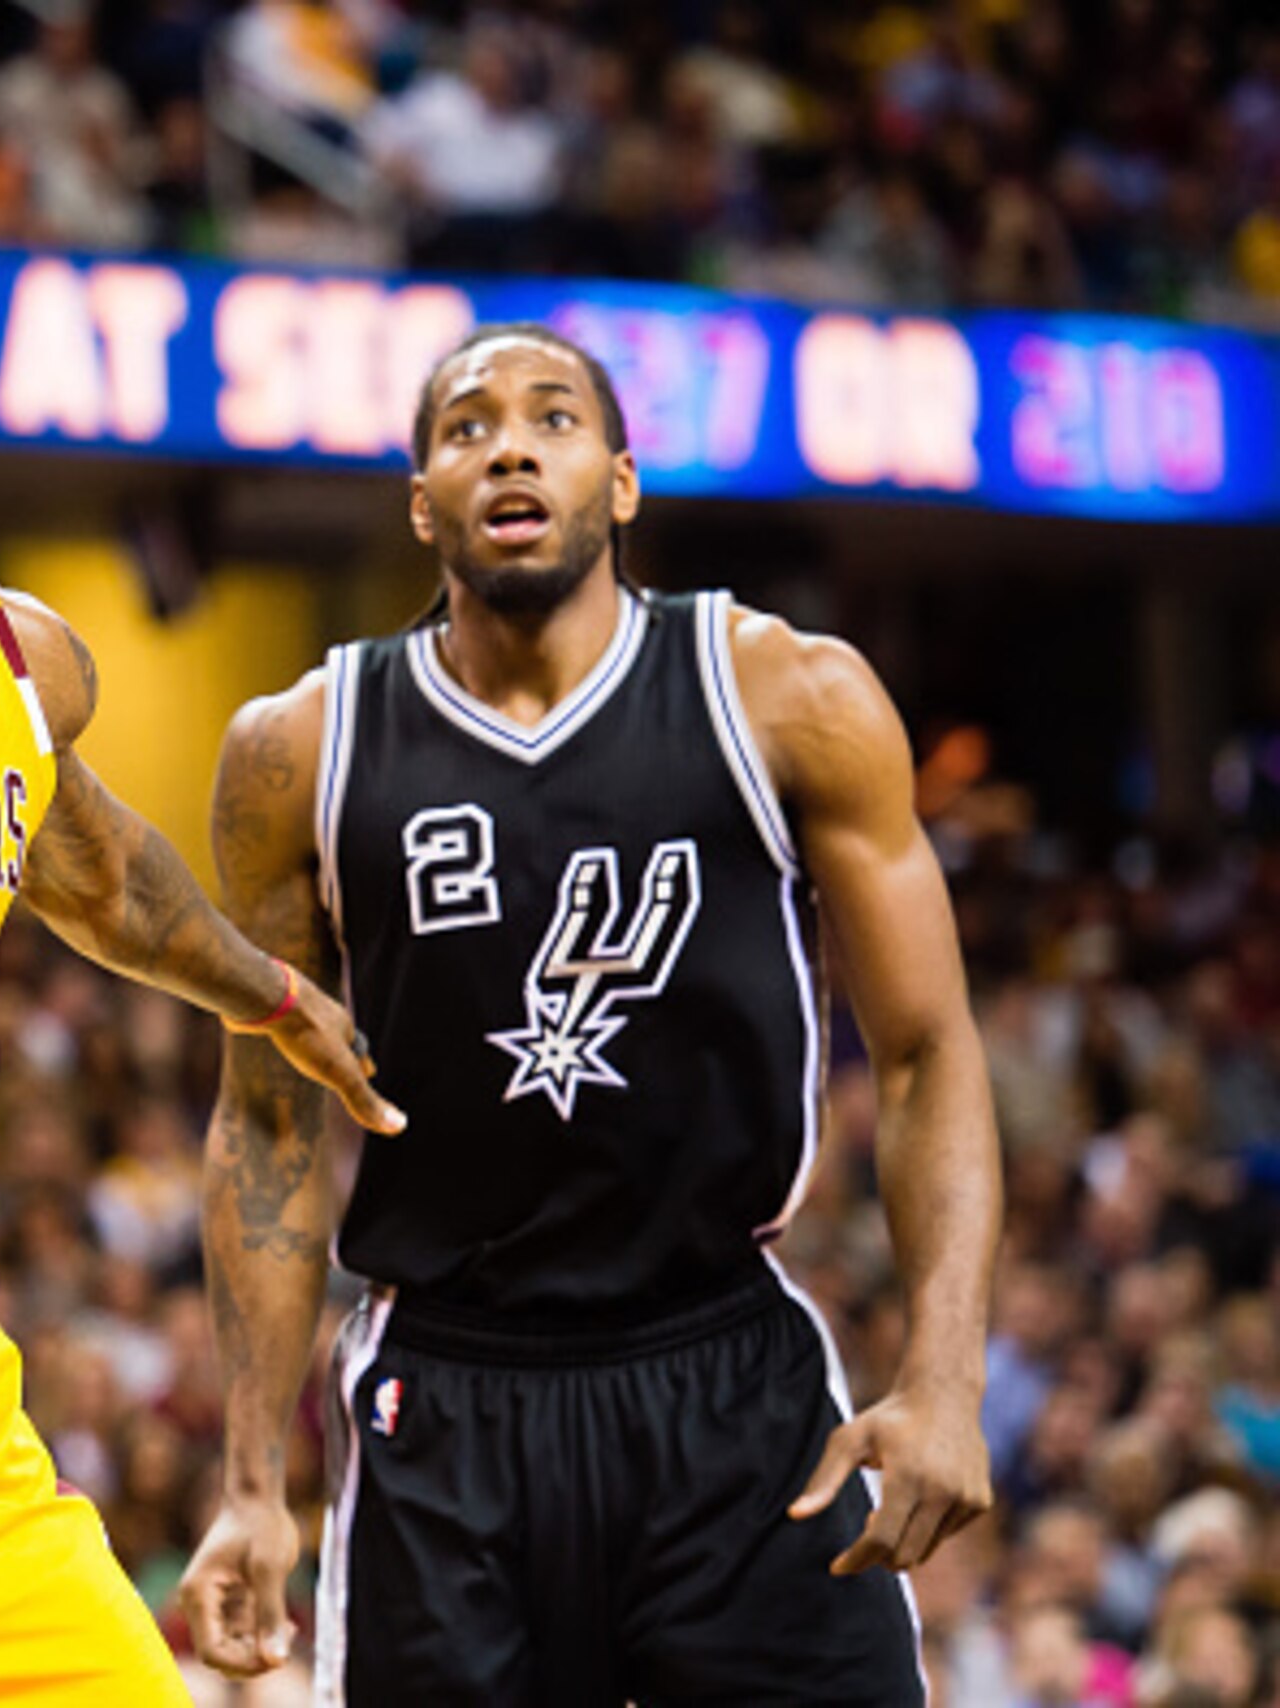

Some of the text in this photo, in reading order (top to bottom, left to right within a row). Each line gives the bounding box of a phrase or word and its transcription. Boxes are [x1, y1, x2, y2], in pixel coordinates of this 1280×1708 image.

[793, 313, 980, 492] OR
[1009, 333, 1225, 494] 210
[402, 804, 502, 934] 2
